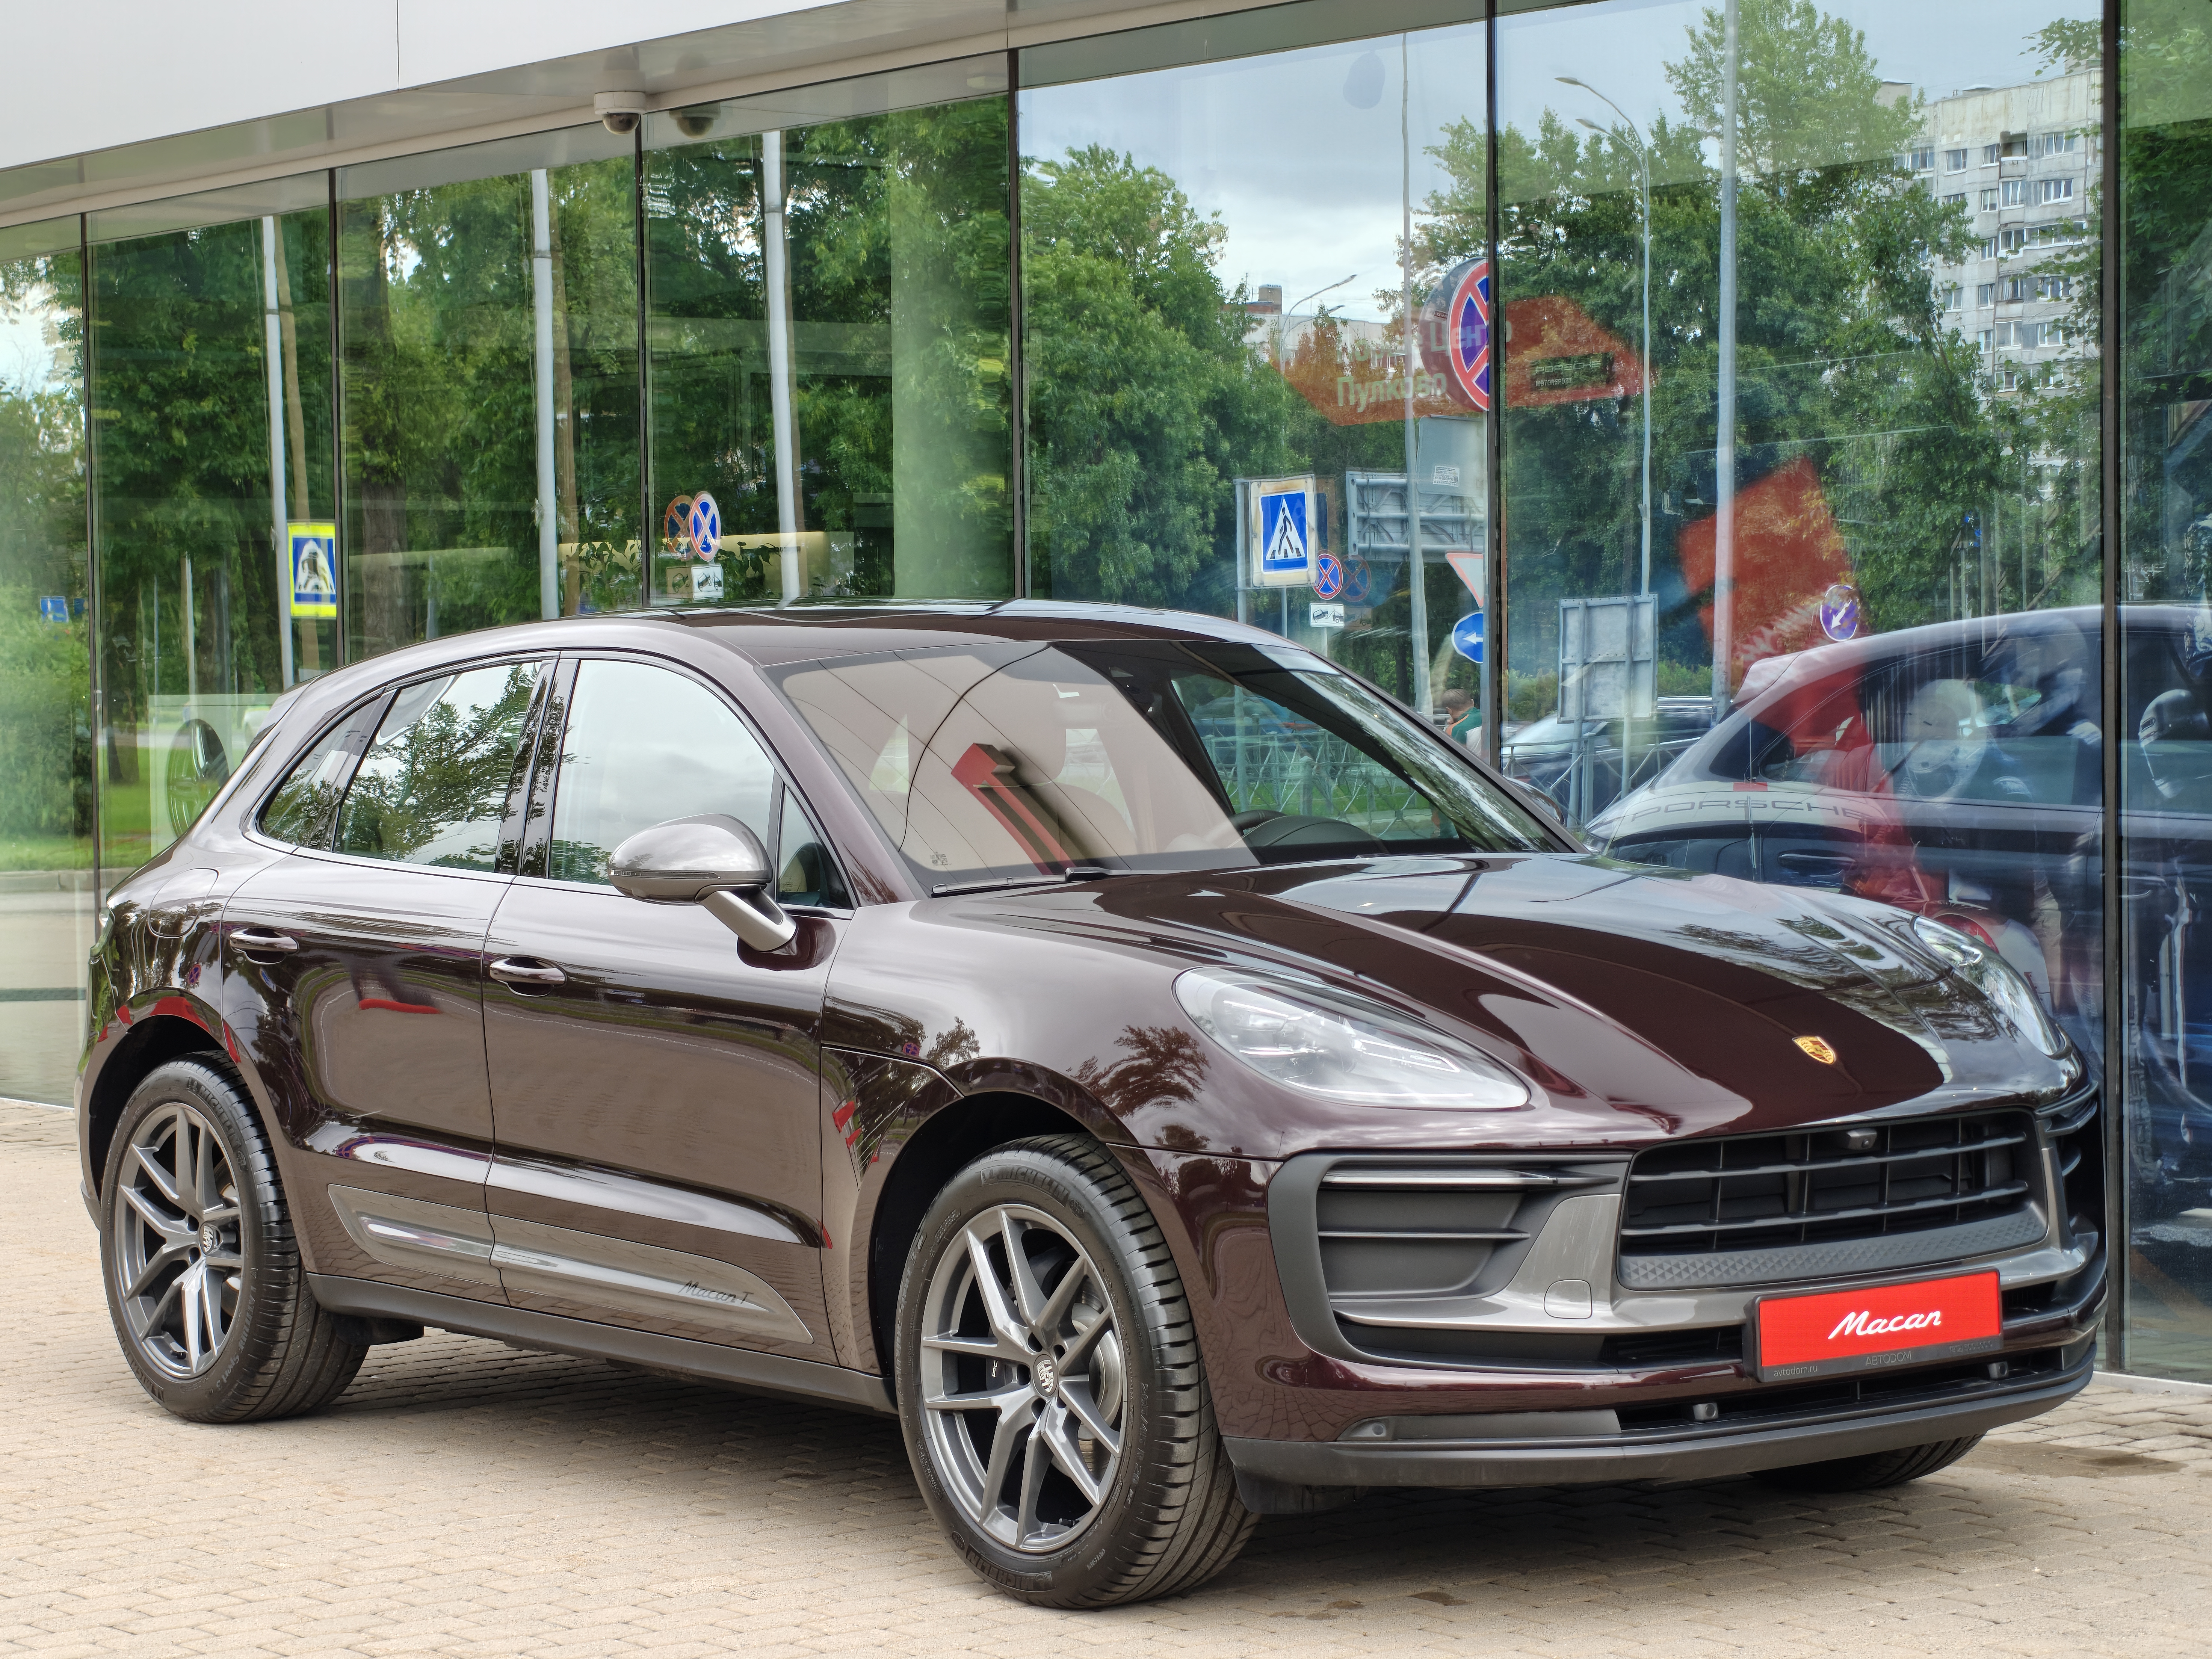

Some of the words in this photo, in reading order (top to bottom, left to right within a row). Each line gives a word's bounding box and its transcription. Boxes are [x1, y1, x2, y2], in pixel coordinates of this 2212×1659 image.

[1337, 373, 1447, 412] Пулково
[1535, 377, 1572, 387] MOTORSPORT
[1630, 799, 1874, 822] PORSCHE
[997, 1166, 1070, 1204] MICHELIN
[678, 1280, 736, 1303] Macan
[740, 1291, 754, 1304] T
[1828, 1310, 1941, 1339] Macan
[1774, 1365, 1818, 1377] avtodom.ru
